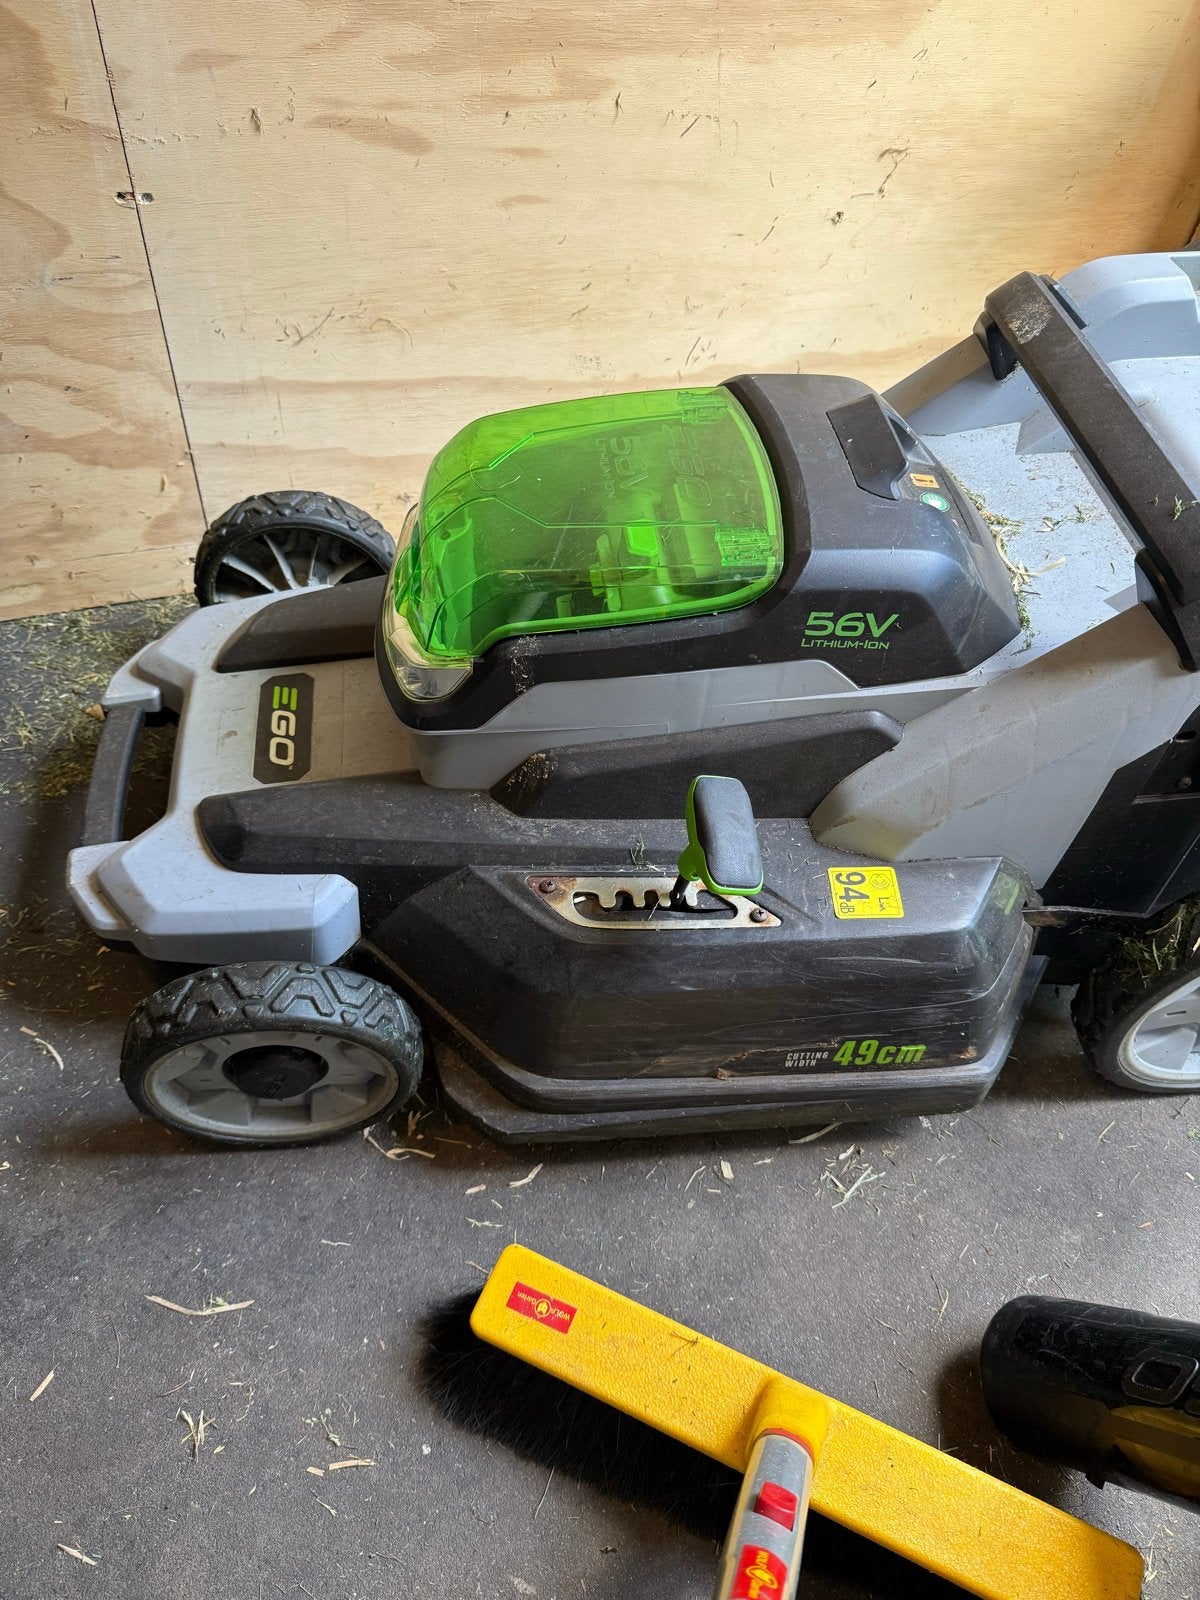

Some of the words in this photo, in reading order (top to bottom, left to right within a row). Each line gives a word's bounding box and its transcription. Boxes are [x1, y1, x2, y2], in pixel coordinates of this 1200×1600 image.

[804, 611, 899, 638] 56V
[269, 686, 298, 766] EGO
[835, 871, 870, 902] 94
[785, 1059, 817, 1068] WIDTH
[786, 1051, 829, 1060] CUTTING
[832, 1039, 927, 1066] 49cm
